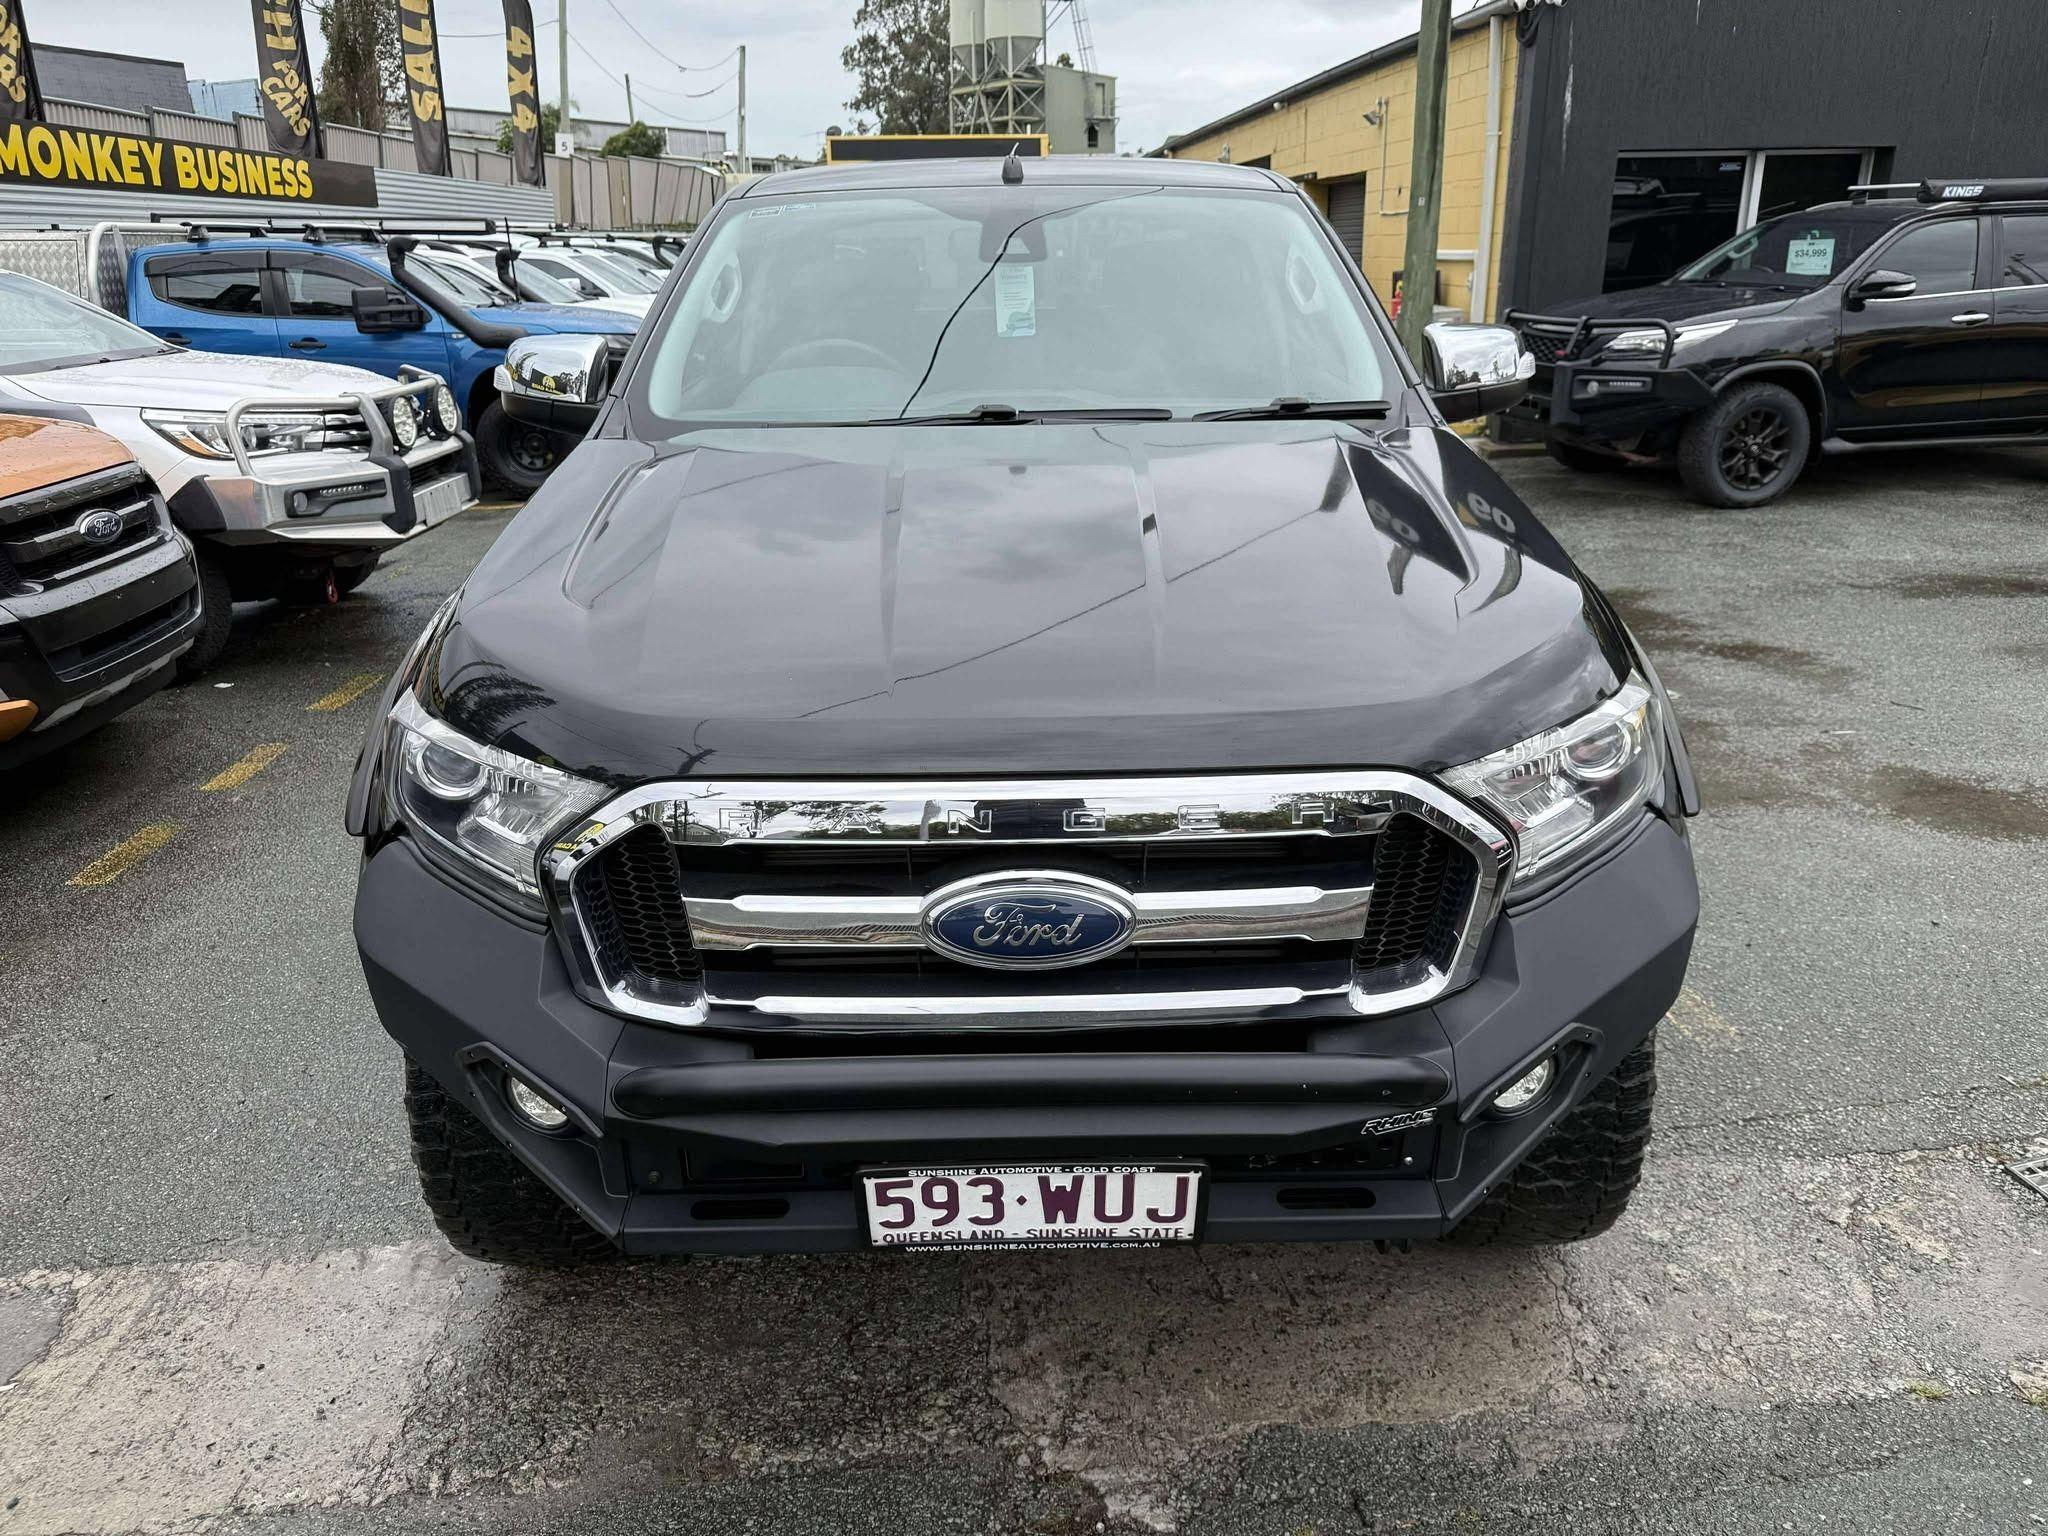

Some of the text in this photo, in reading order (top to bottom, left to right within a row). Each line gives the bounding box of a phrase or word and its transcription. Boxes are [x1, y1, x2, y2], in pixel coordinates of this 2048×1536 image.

[262, 76, 311, 137] CARS
[0, 124, 313, 199] MONKEY BUSINESS
[1942, 185, 1985, 198] KINGS
[1794, 248, 1828, 258] $34,999
[93, 517, 119, 536] Ford
[718, 800, 1336, 835] RANGER
[972, 902, 1083, 948] Ford
[908, 1169, 976, 1177] SUNSHINE
[980, 1166, 1062, 1175] AUTOMOTIVE
[1073, 1166, 1108, 1174] GOLD
[1112, 1166, 1156, 1174] COAST
[882, 1229, 1004, 1244] QUEENSLAND
[1027, 1227, 1118, 1239] SUNSHINE
[1129, 1227, 1184, 1239] STATE
